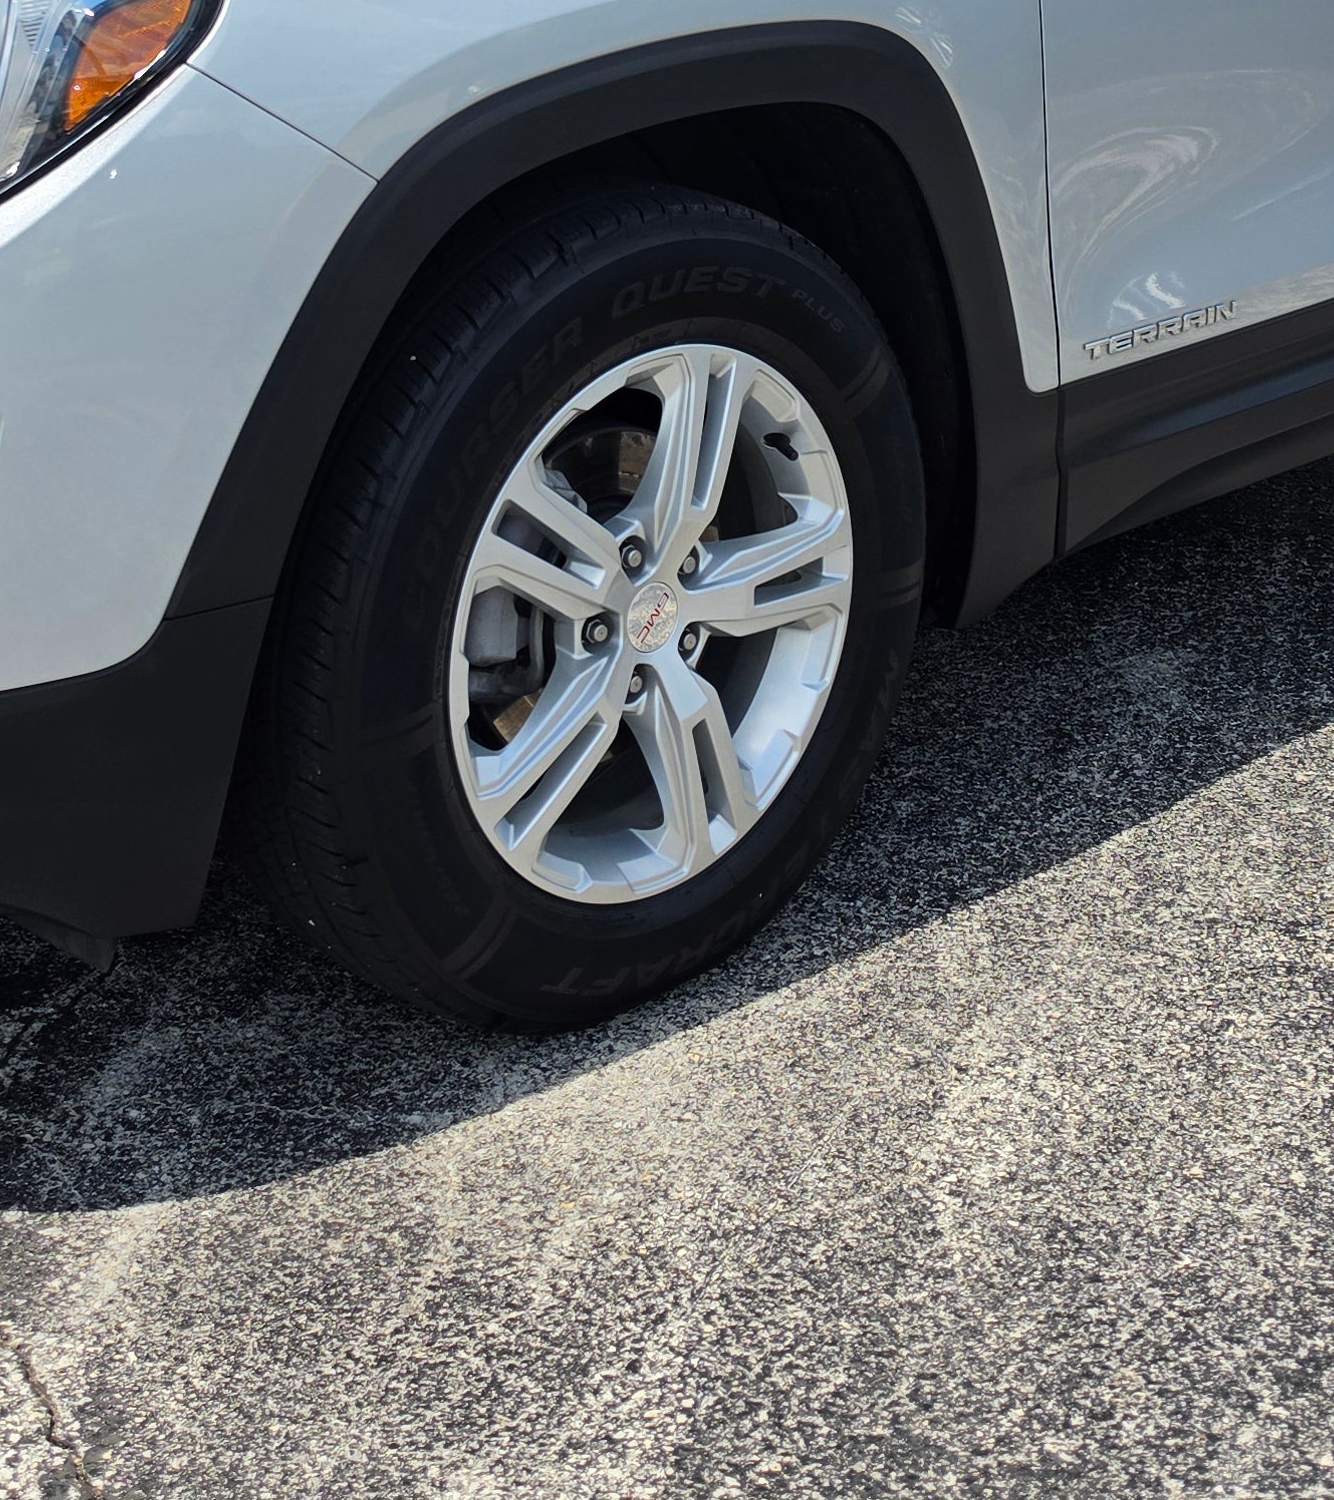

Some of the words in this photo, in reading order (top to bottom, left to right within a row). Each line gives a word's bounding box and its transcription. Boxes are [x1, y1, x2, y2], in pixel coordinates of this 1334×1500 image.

[611, 264, 787, 320] QUEST
[791, 287, 846, 334] PLUS
[1083, 300, 1238, 360] TERRAIN
[636, 591, 670, 644] GMC
